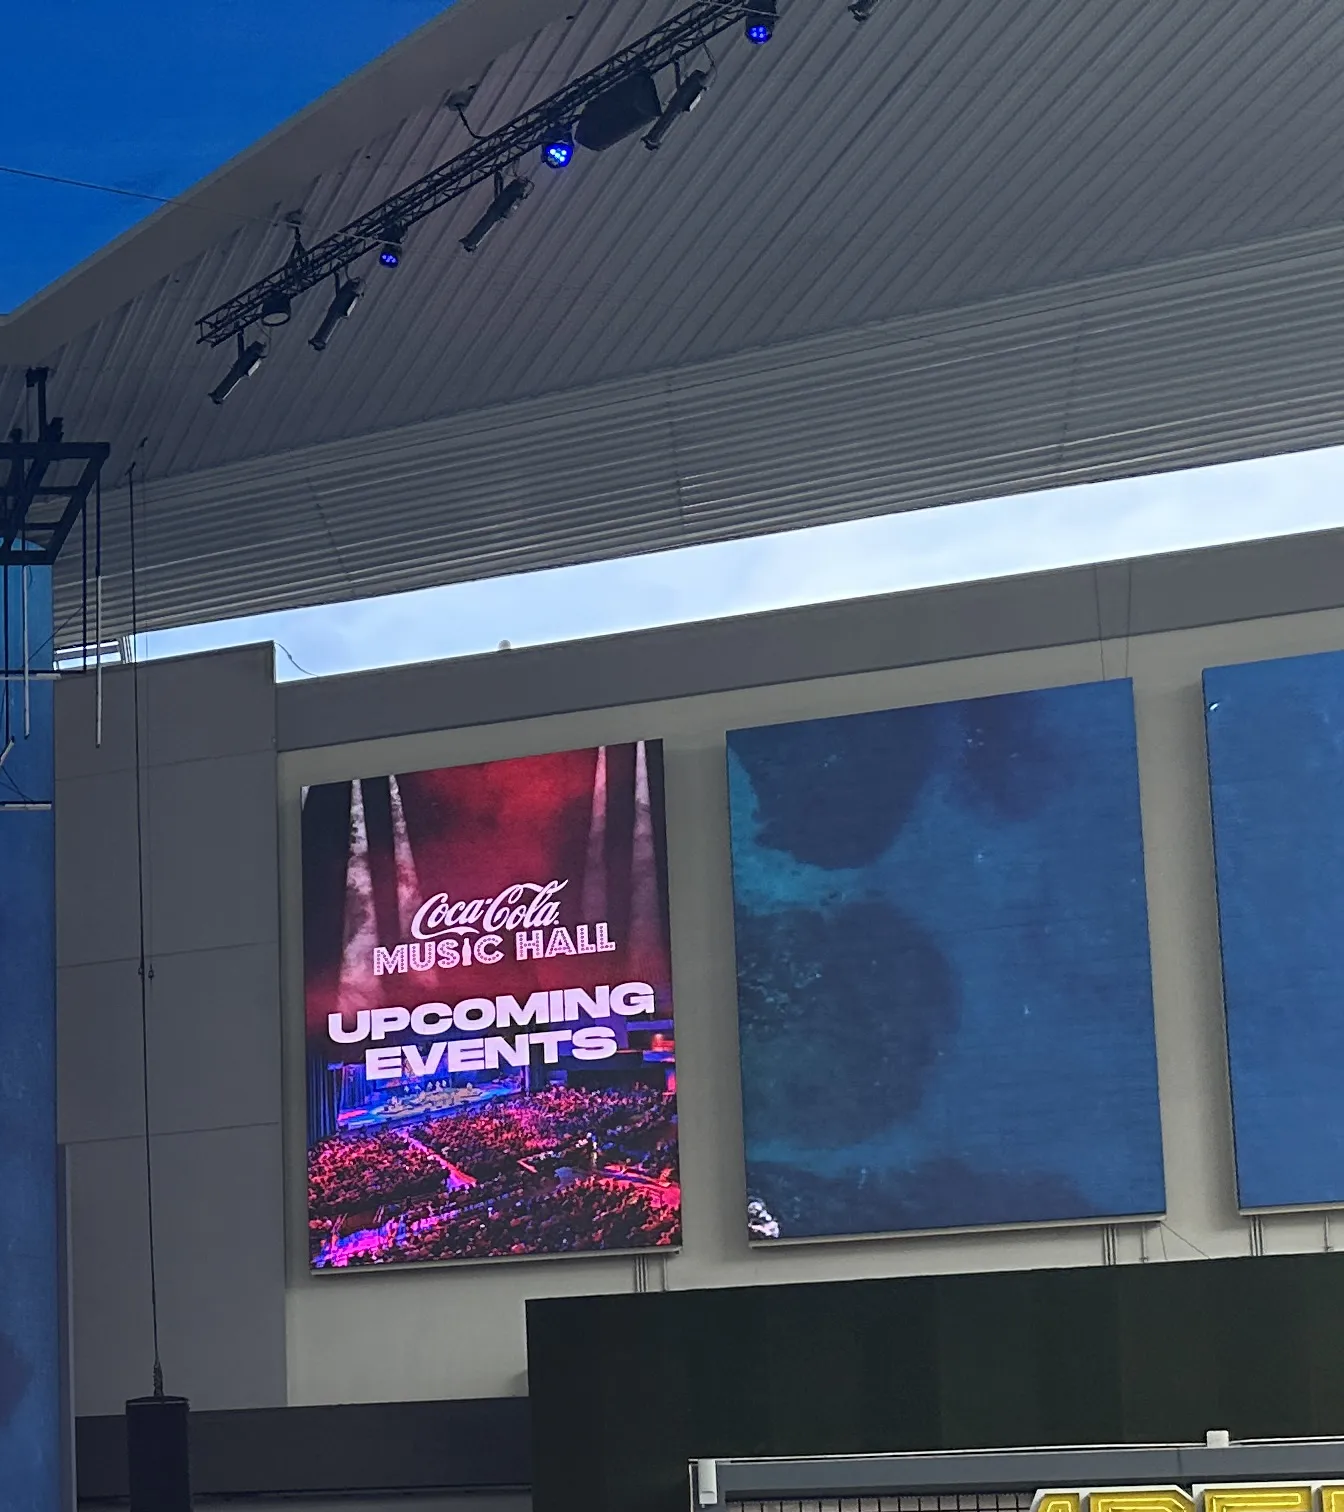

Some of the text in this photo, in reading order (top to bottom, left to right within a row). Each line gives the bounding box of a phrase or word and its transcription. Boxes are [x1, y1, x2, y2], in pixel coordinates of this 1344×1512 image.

[411, 879, 568, 939] Coca-Cola
[373, 922, 616, 976] MUSIC HALL
[327, 981, 655, 1043] UPCOMING
[365, 1025, 618, 1080] EVENTS
